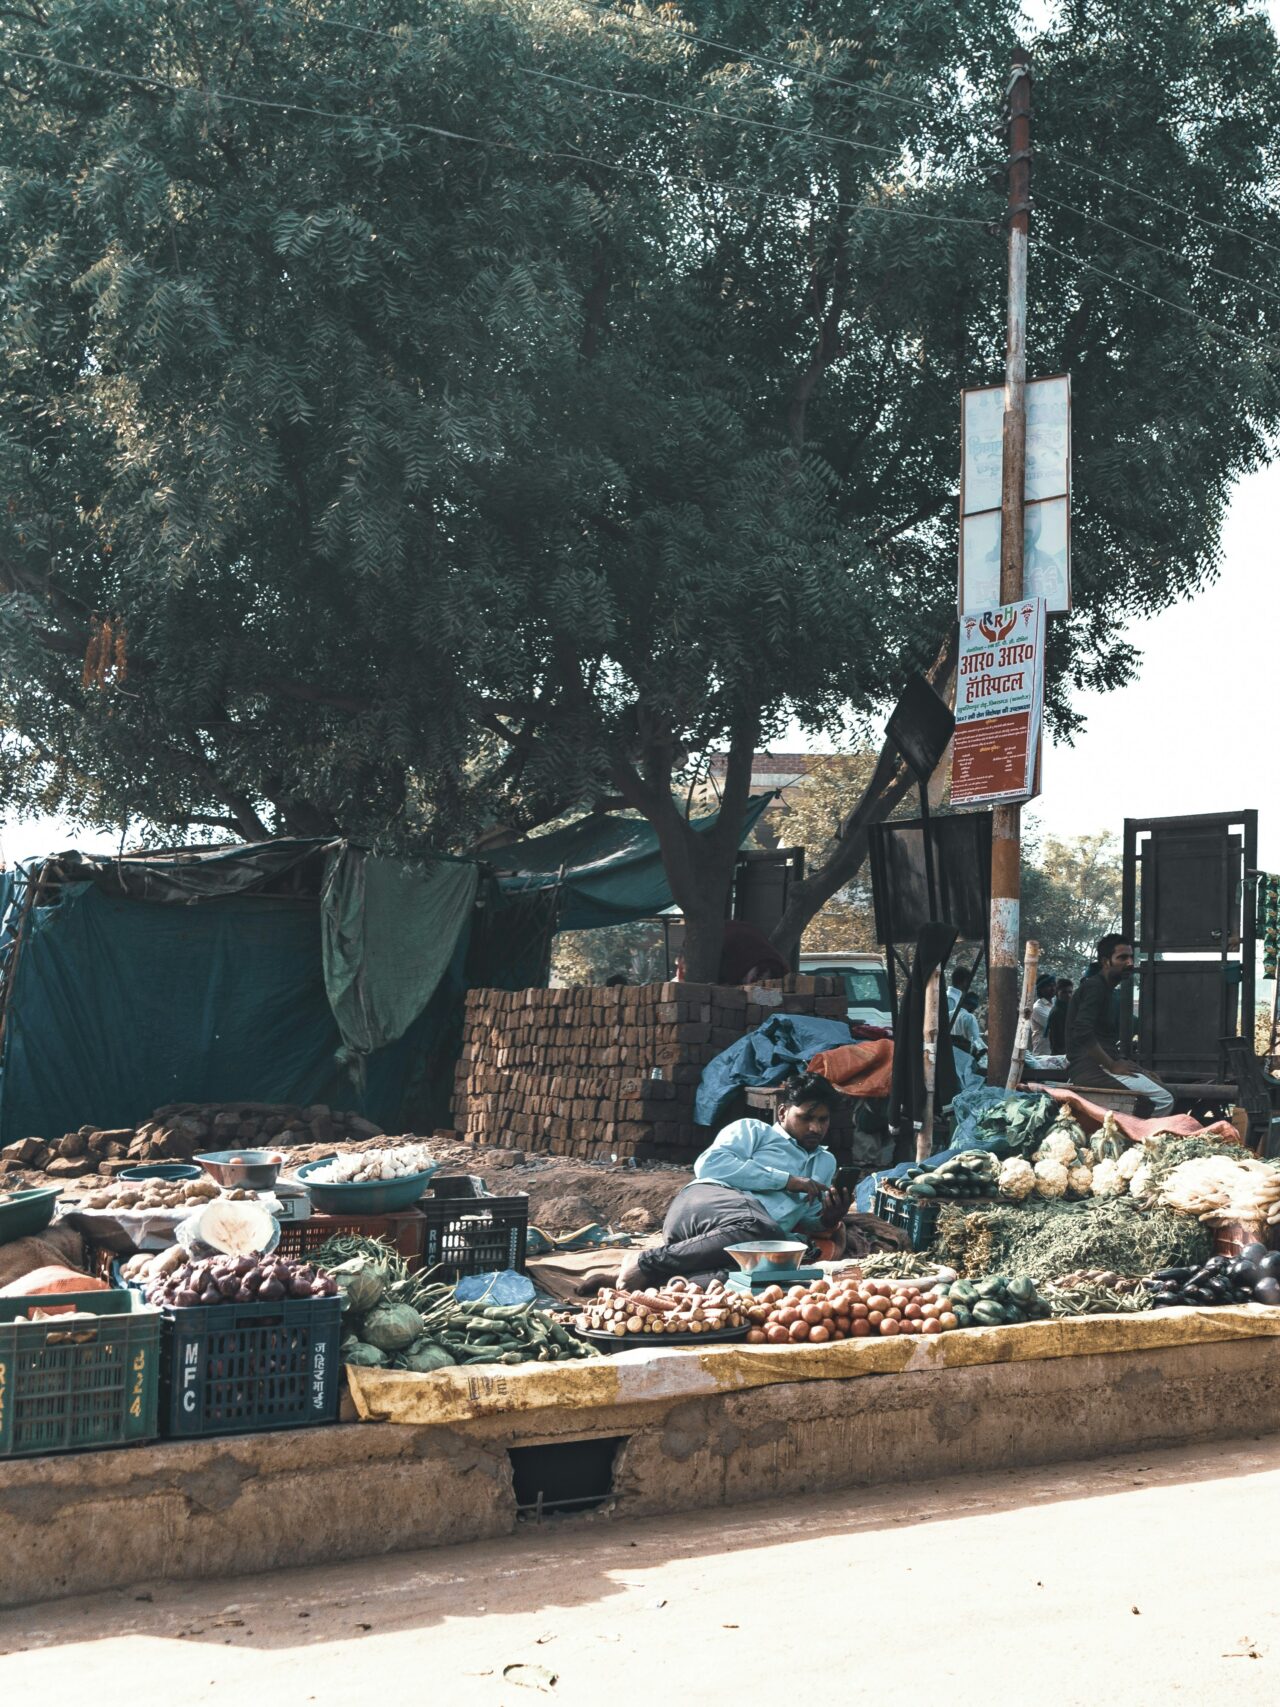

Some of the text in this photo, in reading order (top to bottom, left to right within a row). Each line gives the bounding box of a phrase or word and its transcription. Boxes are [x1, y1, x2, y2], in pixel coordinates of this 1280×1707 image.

[983, 607, 1013, 628] RRH
[966, 672, 1025, 703] हॉस्पिटल
[183, 1343, 199, 1412] MFC
